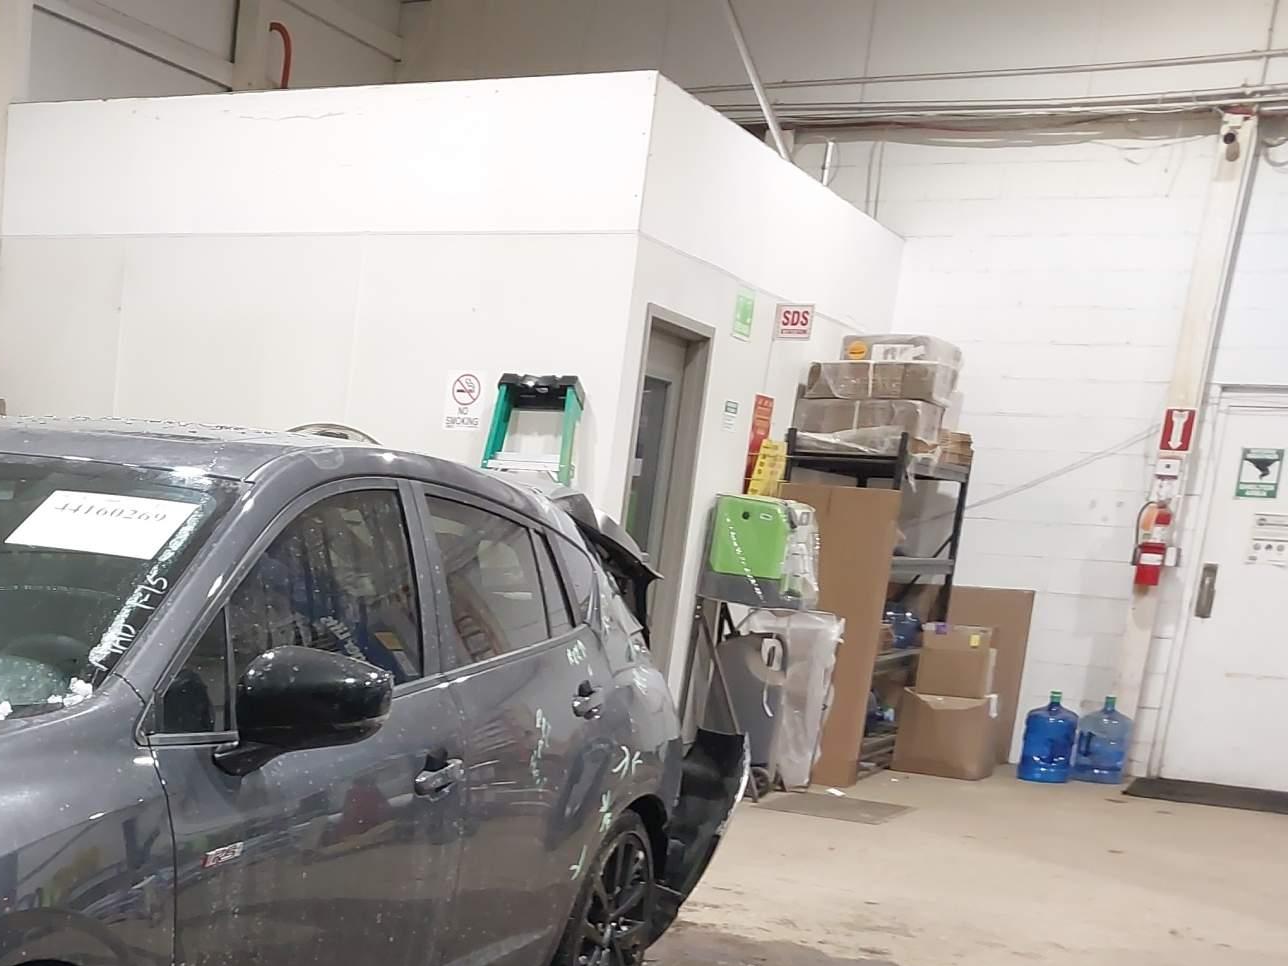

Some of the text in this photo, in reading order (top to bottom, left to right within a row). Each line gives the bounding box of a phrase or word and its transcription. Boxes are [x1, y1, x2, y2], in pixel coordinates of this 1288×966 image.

[782, 310, 810, 326] SDS
[457, 406, 469, 416] NO
[444, 416, 479, 426] SMOKING
